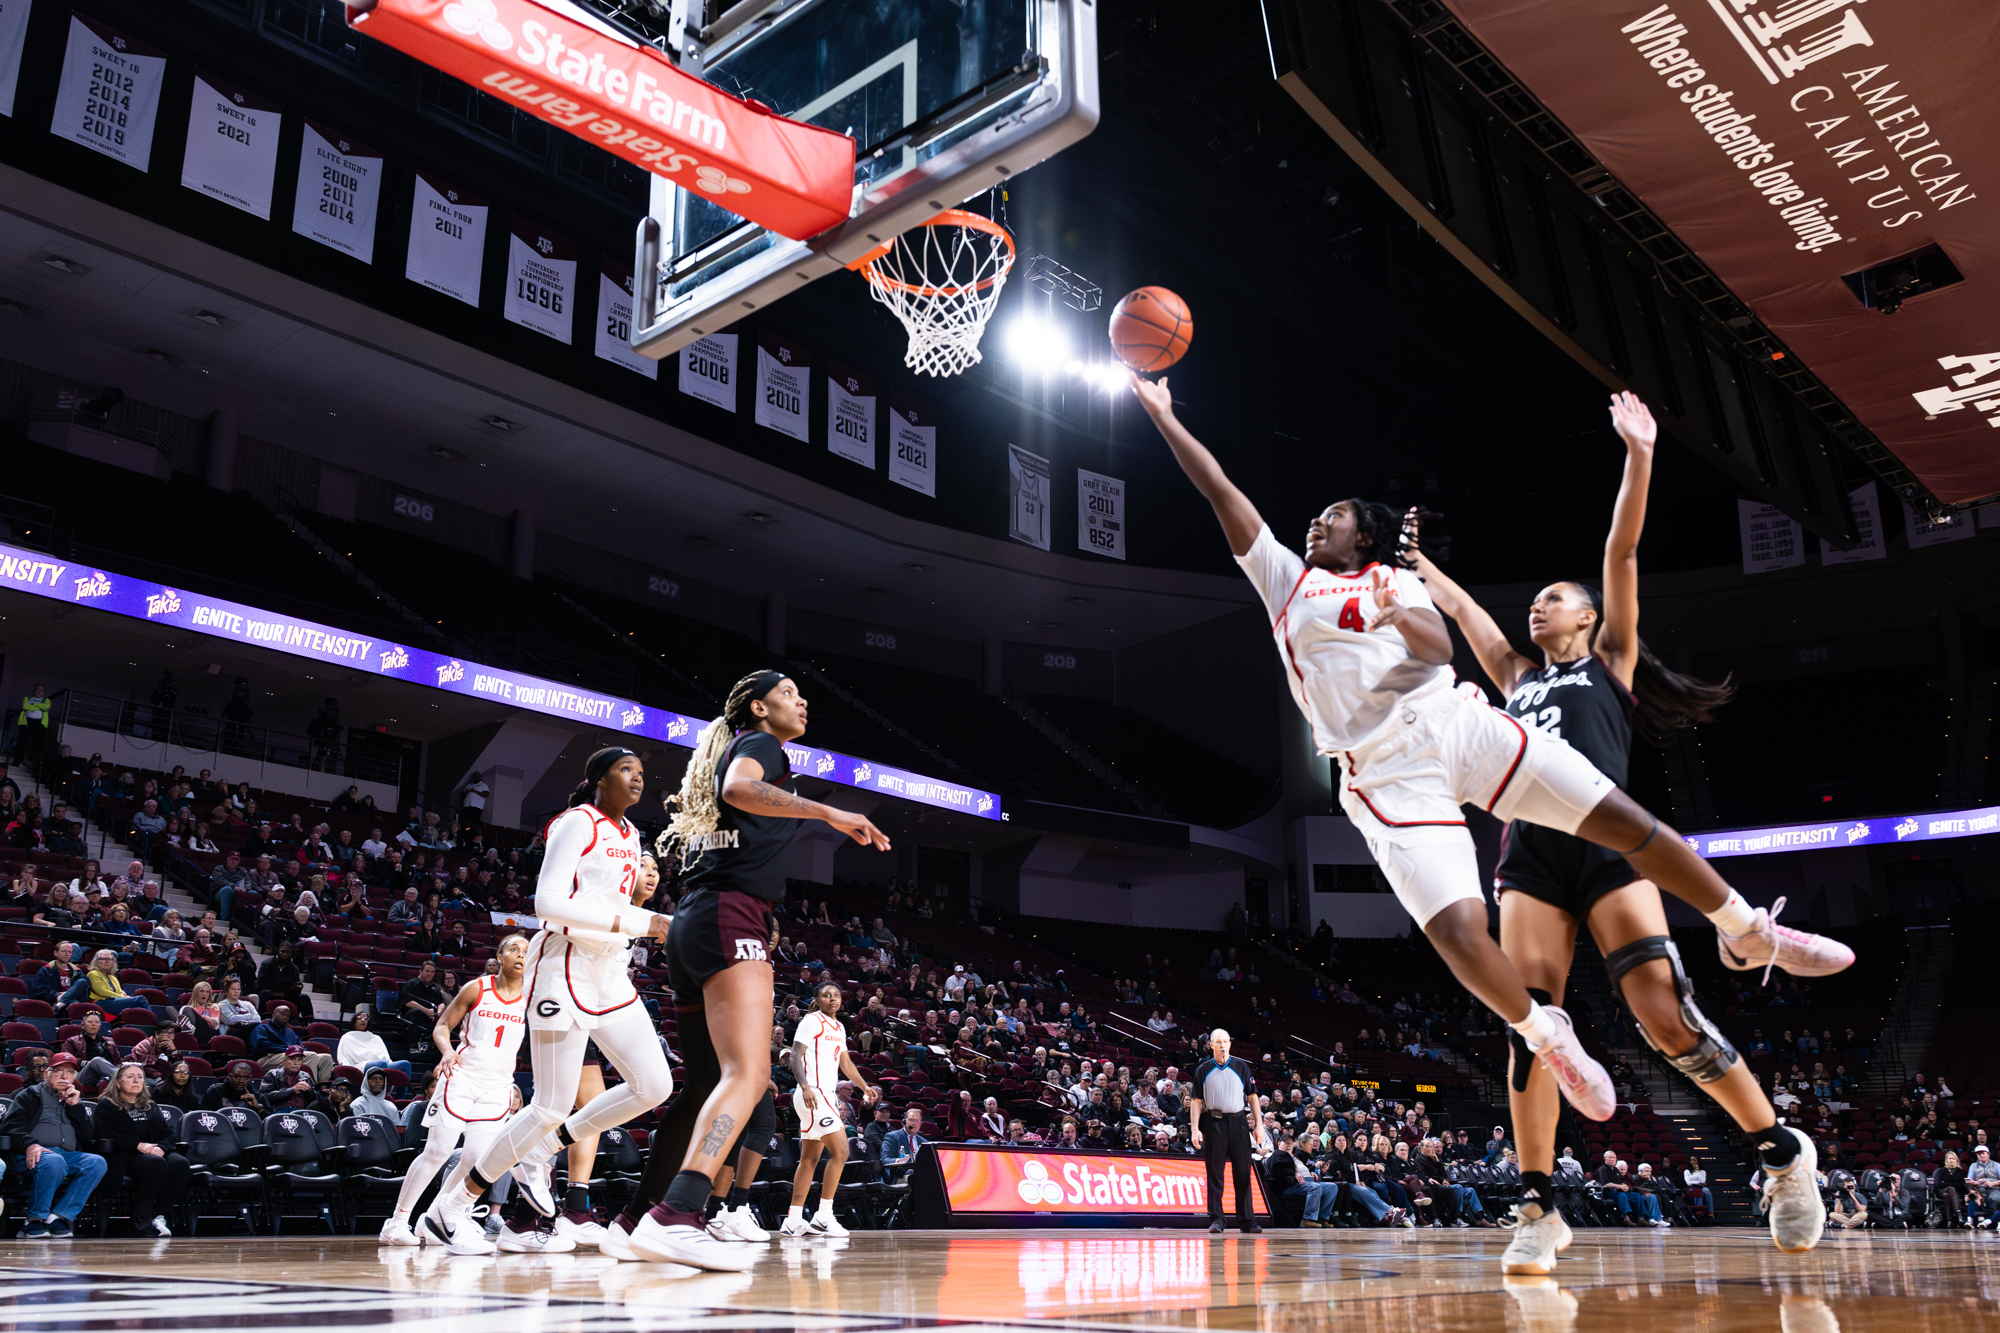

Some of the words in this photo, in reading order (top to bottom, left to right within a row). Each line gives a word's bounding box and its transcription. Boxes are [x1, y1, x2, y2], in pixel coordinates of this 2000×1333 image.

[92, 46, 127, 68] SWEET
[129, 63, 140, 74] 16
[92, 63, 133, 93] 2012
[89, 81, 131, 111] 2014
[86, 98, 128, 128] 2018
[217, 103, 246, 122] SWEET
[247, 116, 257, 127] 16
[83, 115, 125, 146] 2019
[217, 120, 251, 146] 2021
[1620, 3, 1706, 89] Where
[1679, 83, 1775, 170] students
[1749, 160, 1805, 205] love
[1780, 197, 1843, 253] living.
[1841, 64, 1977, 210] AMERICAN
[317, 147, 341, 165] ELITE
[343, 159, 368, 176] EIGHT
[1790, 86, 1923, 228] CAMPUS
[322, 165, 358, 192] 2008
[323, 182, 354, 208] 2011
[319, 198, 354, 225] 2014
[429, 199, 451, 216] FINAL
[453, 211, 473, 225] FOUR
[435, 217, 463, 240] 2011
[520, 269, 564, 292] CHAMPIONSHIP
[525, 265, 560, 283] TOURNAMENT
[527, 259, 560, 278] CONFERENCE
[517, 277, 564, 315] 1996
[607, 315, 630, 342] 20
[691, 344, 729, 364] CHAMPIONSHIP
[688, 352, 729, 385] 2008
[771, 368, 797, 383] CONFERENCE
[767, 377, 801, 395] CHAMPIONSHIP
[766, 385, 800, 415] 2010
[835, 414, 868, 443] 2013
[897, 441, 927, 469] 2021
[1083, 479, 1101, 492] GARY
[1101, 484, 1120, 496] BLAIR
[393, 496, 434, 520] 206
[1025, 501, 1035, 515] 23
[1088, 494, 1115, 516] 2011
[1089, 528, 1115, 549] 852
[649, 576, 679, 597] 207
[1338, 597, 1365, 633] 4
[865, 631, 895, 650] 208
[192, 605, 244, 634] IGNITE
[245, 618, 285, 642] YOUR
[284, 625, 373, 660] INTENSITY
[473, 674, 513, 699] IGNITE
[515, 685, 545, 705] YOUR
[545, 689, 615, 720] INTENSITY
[1043, 653, 1075, 669] 209
[1519, 705, 1561, 739] 2
[877, 774, 904, 793] IGNITE
[905, 782, 926, 797] YOUR
[926, 783, 973, 807] INTENSITY
[1001, 812, 1009, 821] CC
[1708, 839, 1741, 853] IGNITE
[1743, 836, 1771, 851] YOUR
[1771, 827, 1838, 847] INTENSITY
[1928, 819, 1965, 835] IGNITE
[1966, 813, 1998, 831] YOUR
[619, 863, 636, 897] 21
[494, 1025, 505, 1048] 1
